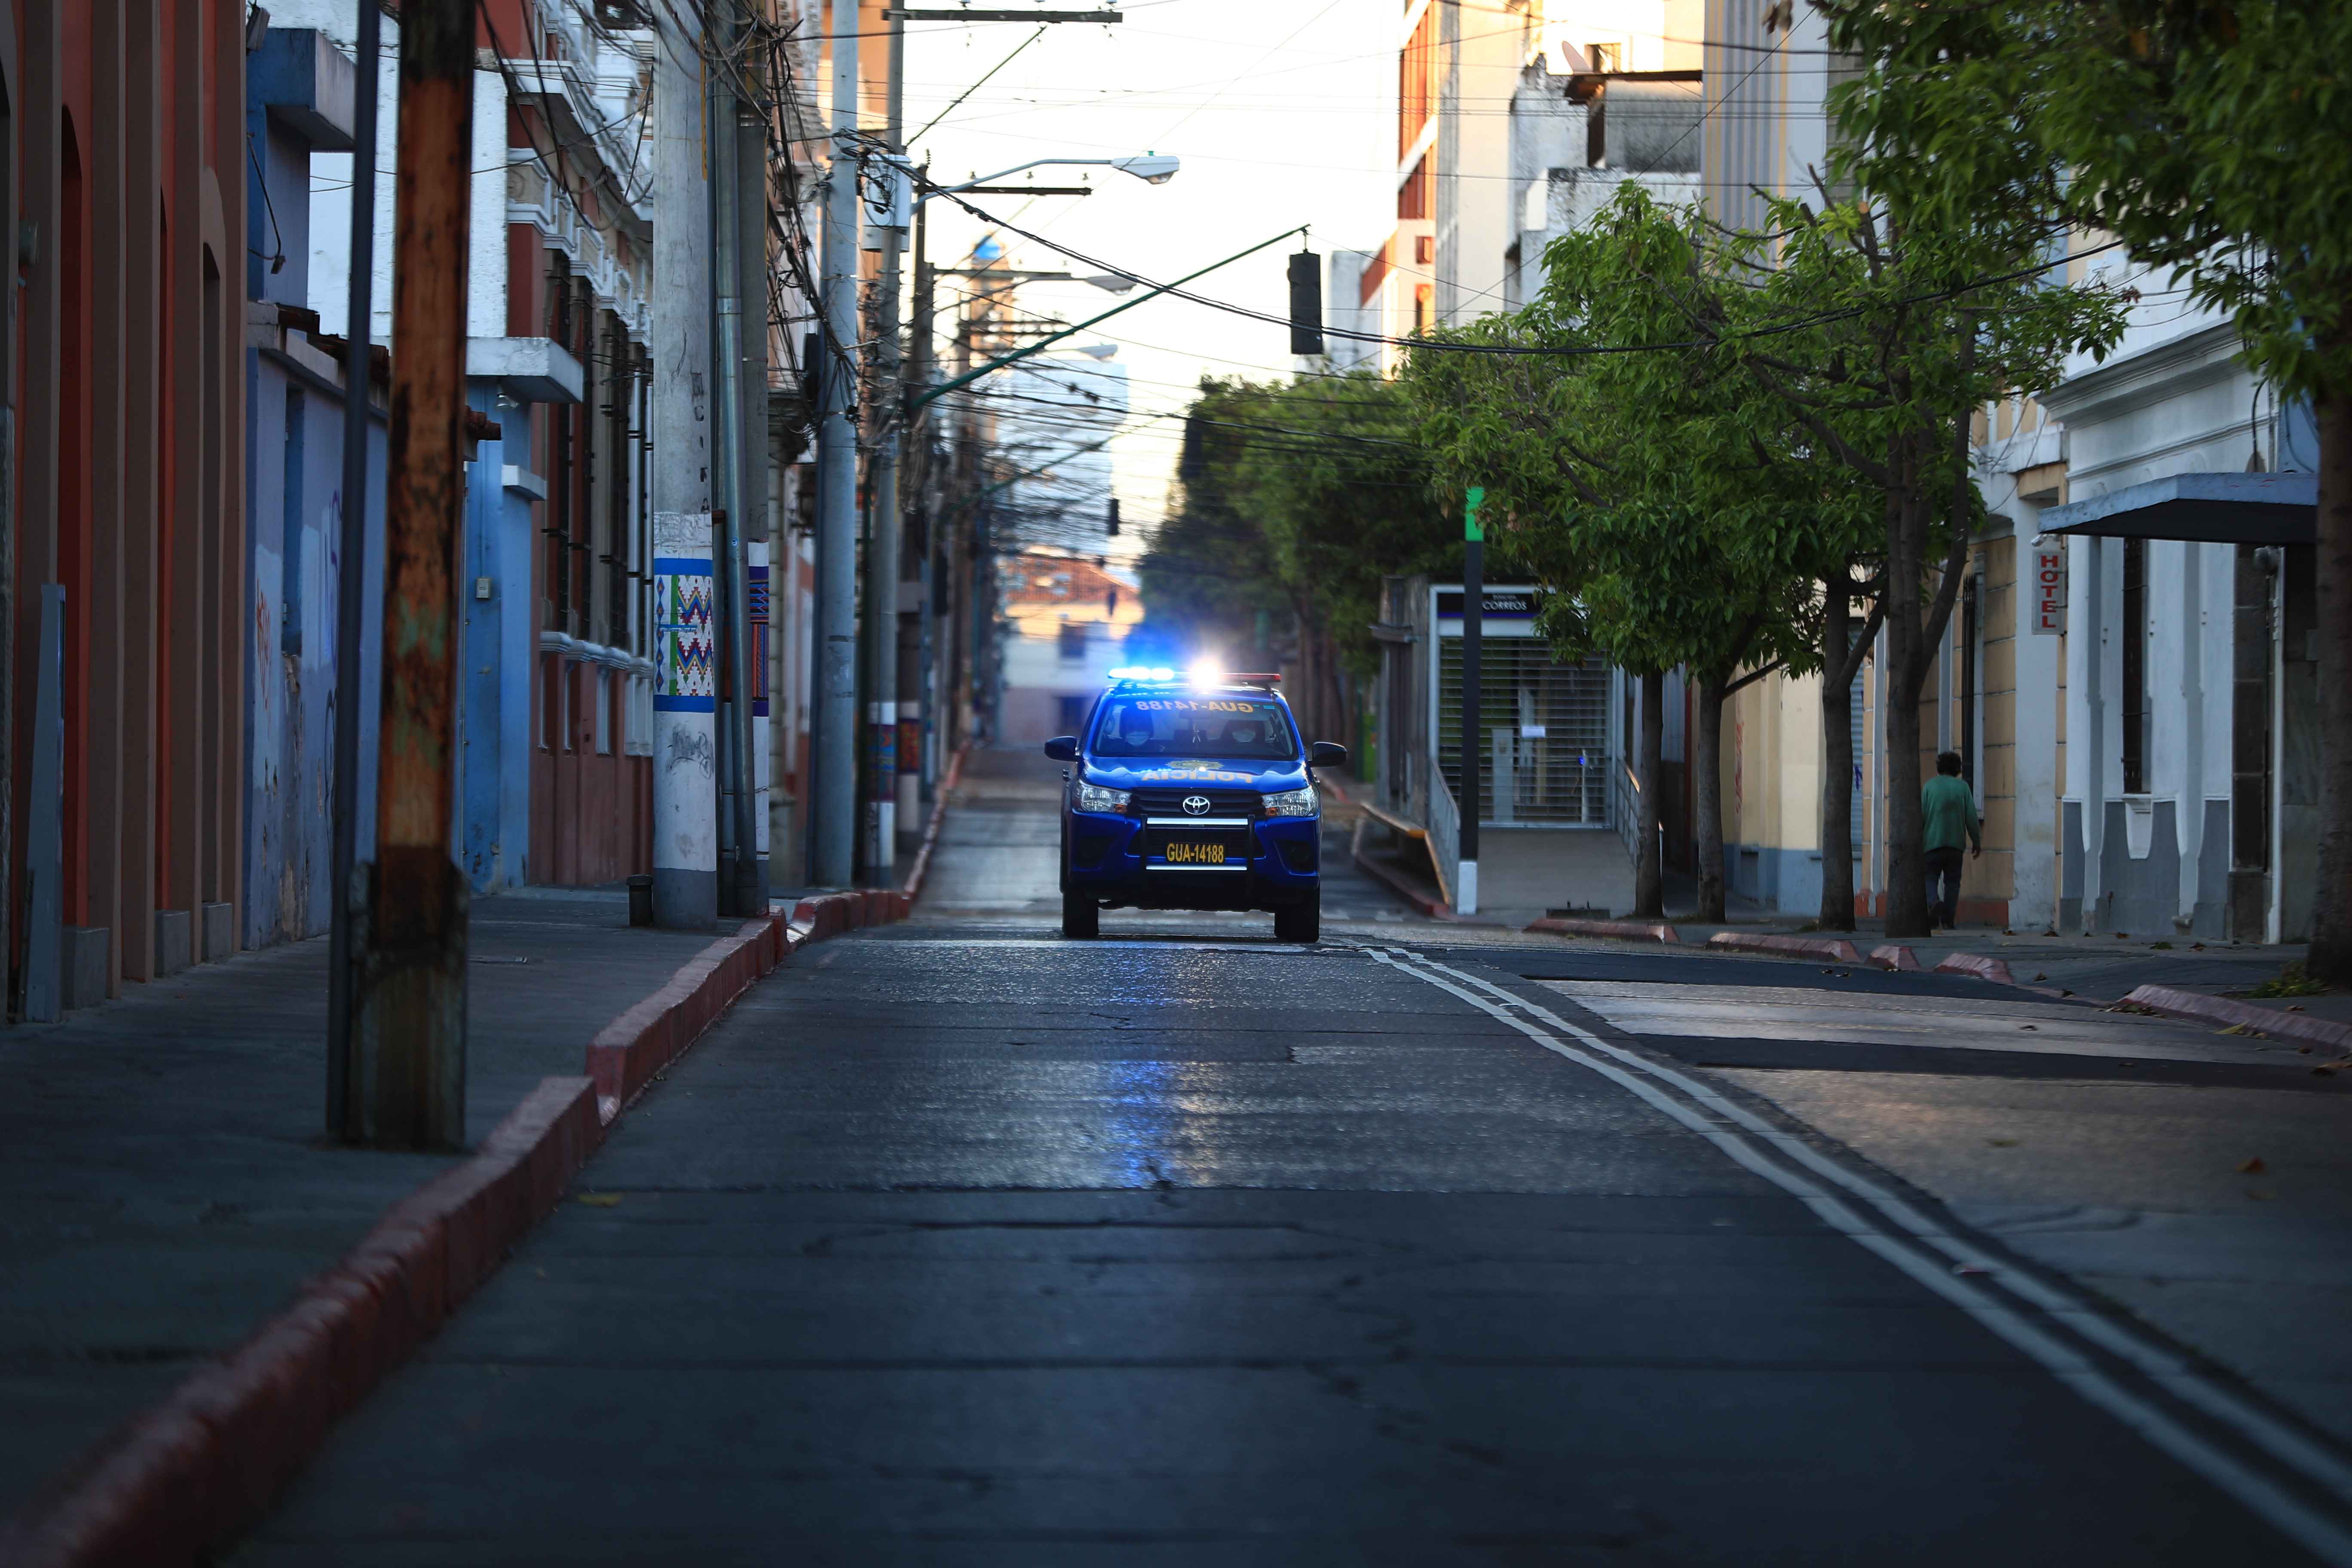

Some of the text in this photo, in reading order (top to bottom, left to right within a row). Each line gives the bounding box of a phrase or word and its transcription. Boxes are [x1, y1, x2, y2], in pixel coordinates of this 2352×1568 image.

[2040, 555, 2058, 628] HOTEL
[1482, 600, 1527, 610] CORREOS
[1167, 843, 1224, 863] GUA-14188
